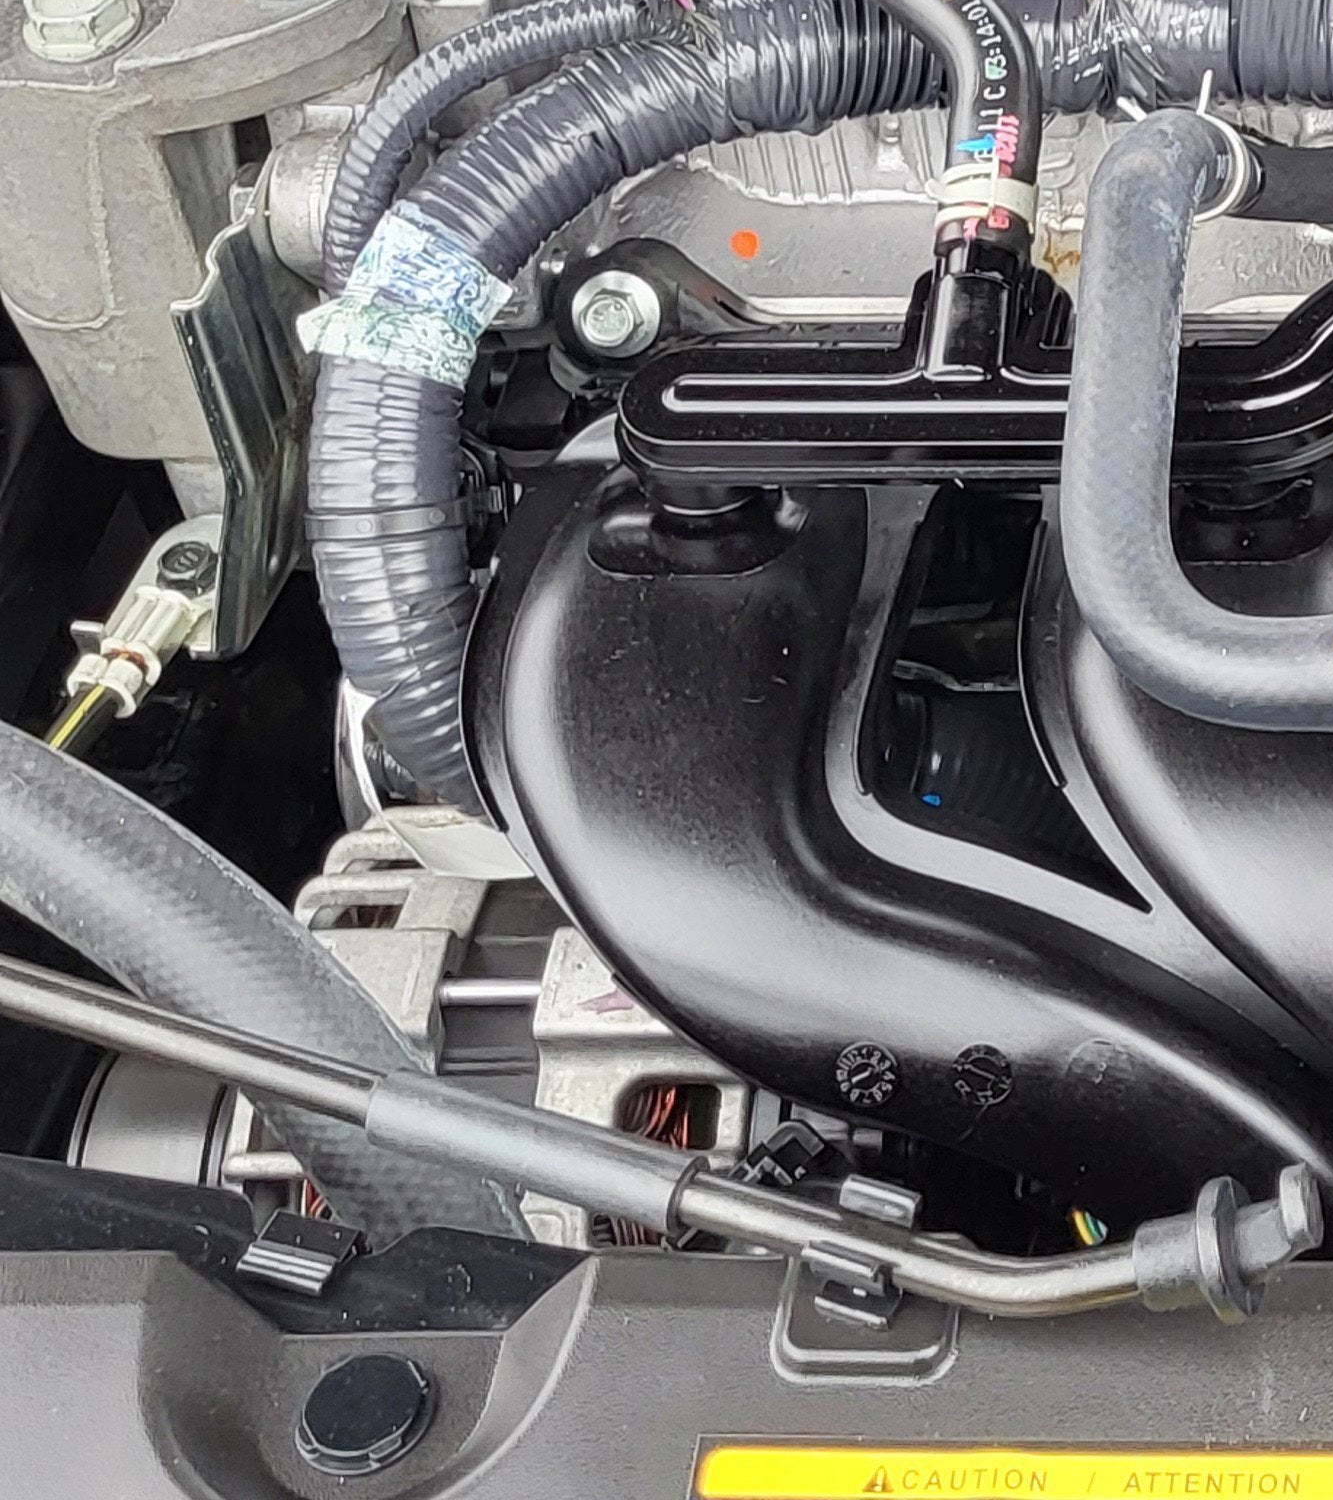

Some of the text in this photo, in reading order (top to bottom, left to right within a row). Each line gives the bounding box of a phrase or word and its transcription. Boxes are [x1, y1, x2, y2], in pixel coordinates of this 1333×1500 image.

[900, 1468, 1303, 1495] CAUTION / ATTENTION
